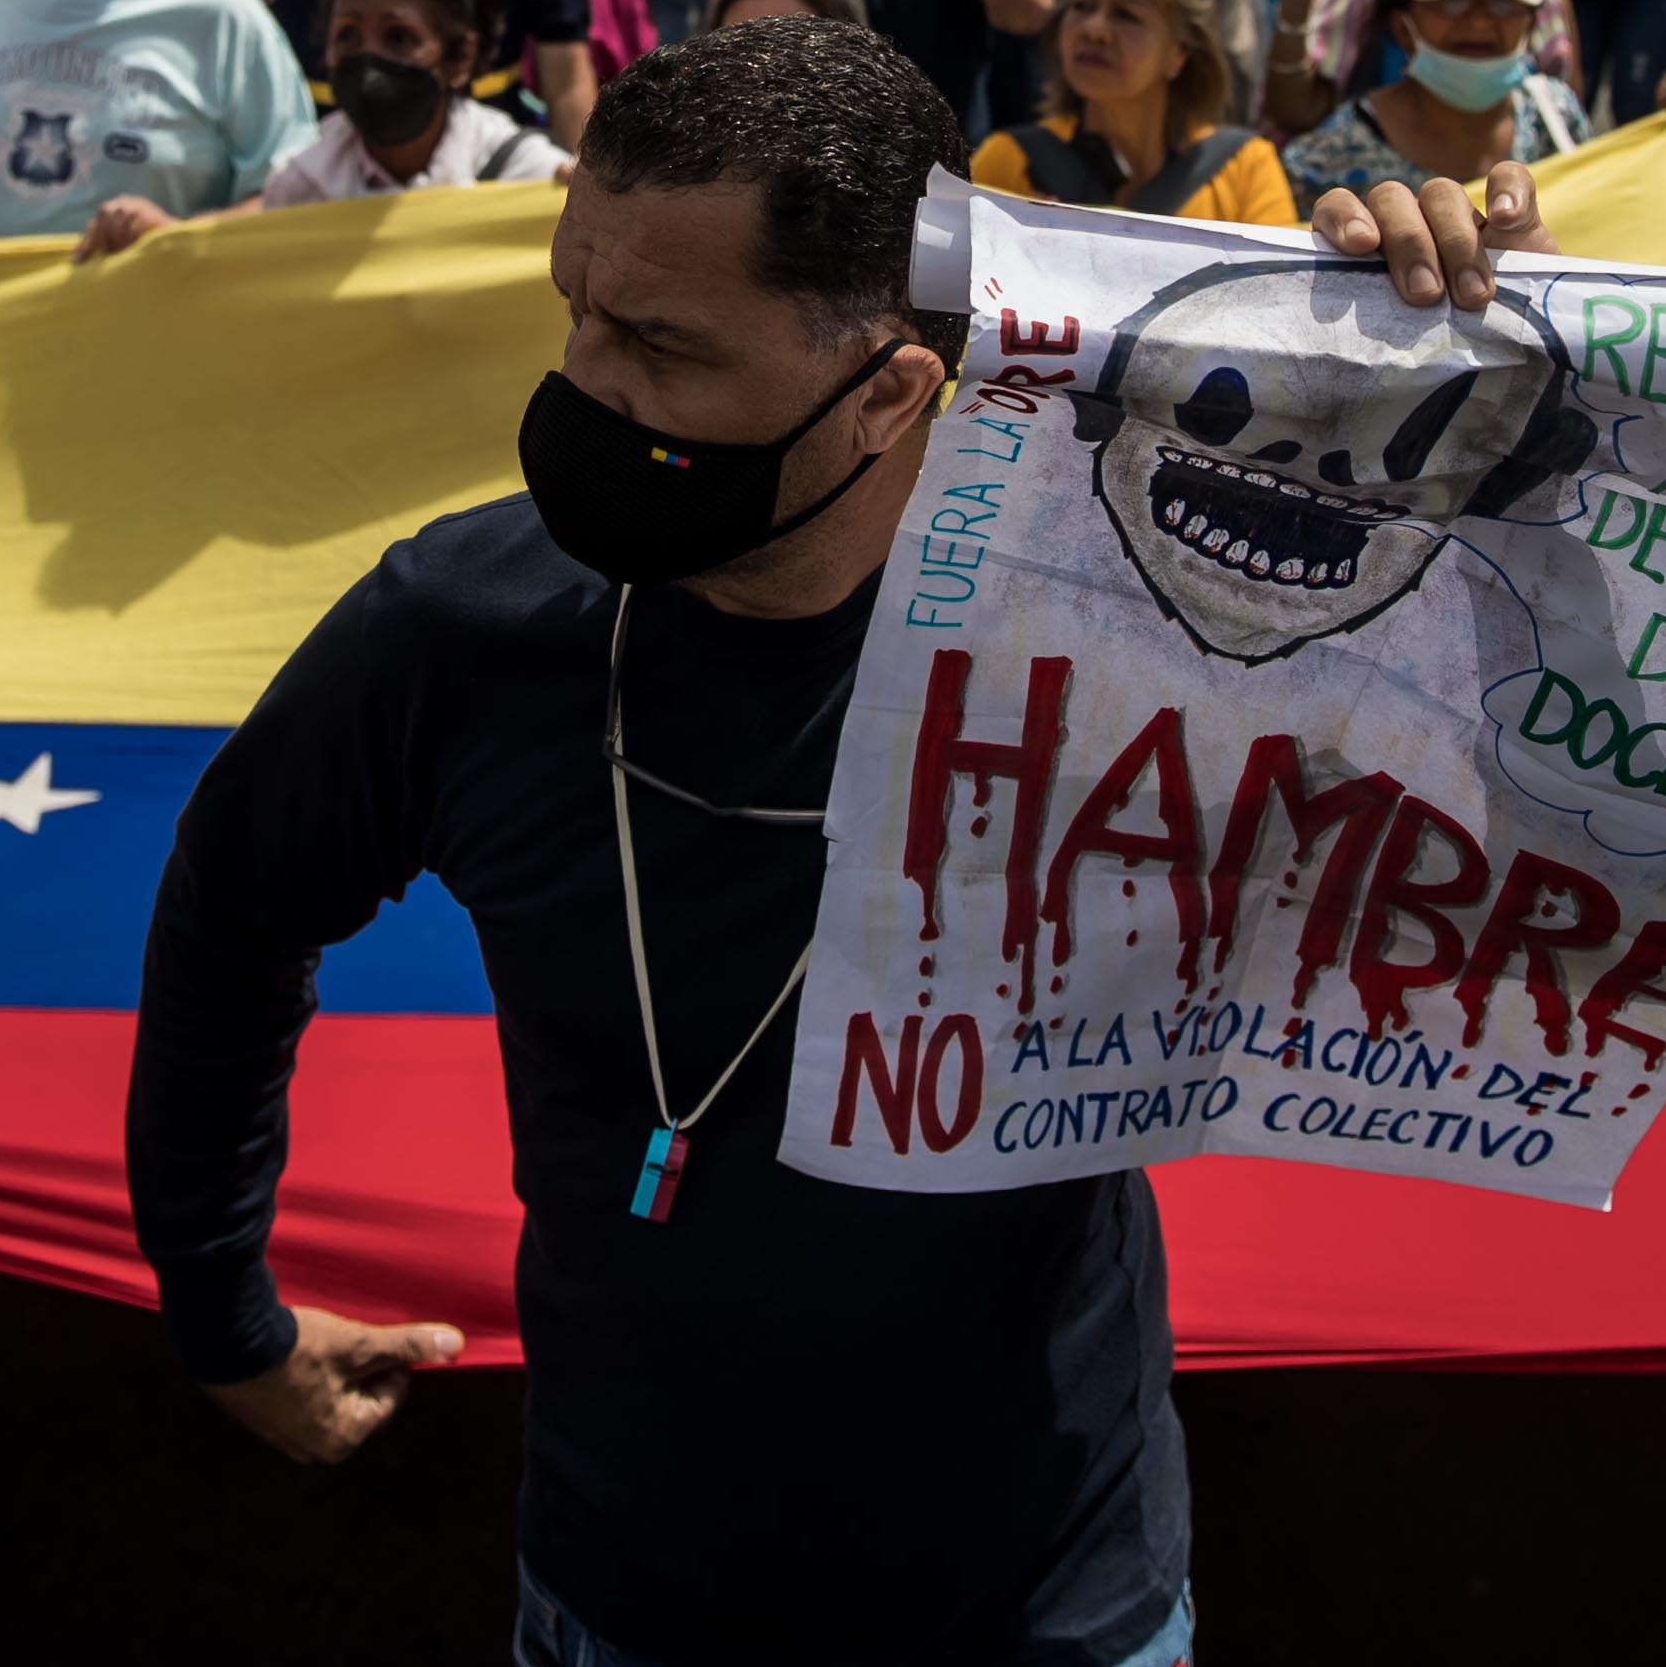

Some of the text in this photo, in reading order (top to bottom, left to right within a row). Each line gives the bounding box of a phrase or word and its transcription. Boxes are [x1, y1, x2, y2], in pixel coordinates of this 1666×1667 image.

[906, 483, 1005, 628] FUERA
[956, 417, 1031, 463] LA
[830, 1011, 983, 1154] NO
[993, 1075, 1555, 1167] CONTRATO COLECTIVO
[1011, 1019, 1050, 1075] A
[1066, 1012, 1133, 1070] LA
[1478, 1062, 1594, 1119] DEL
